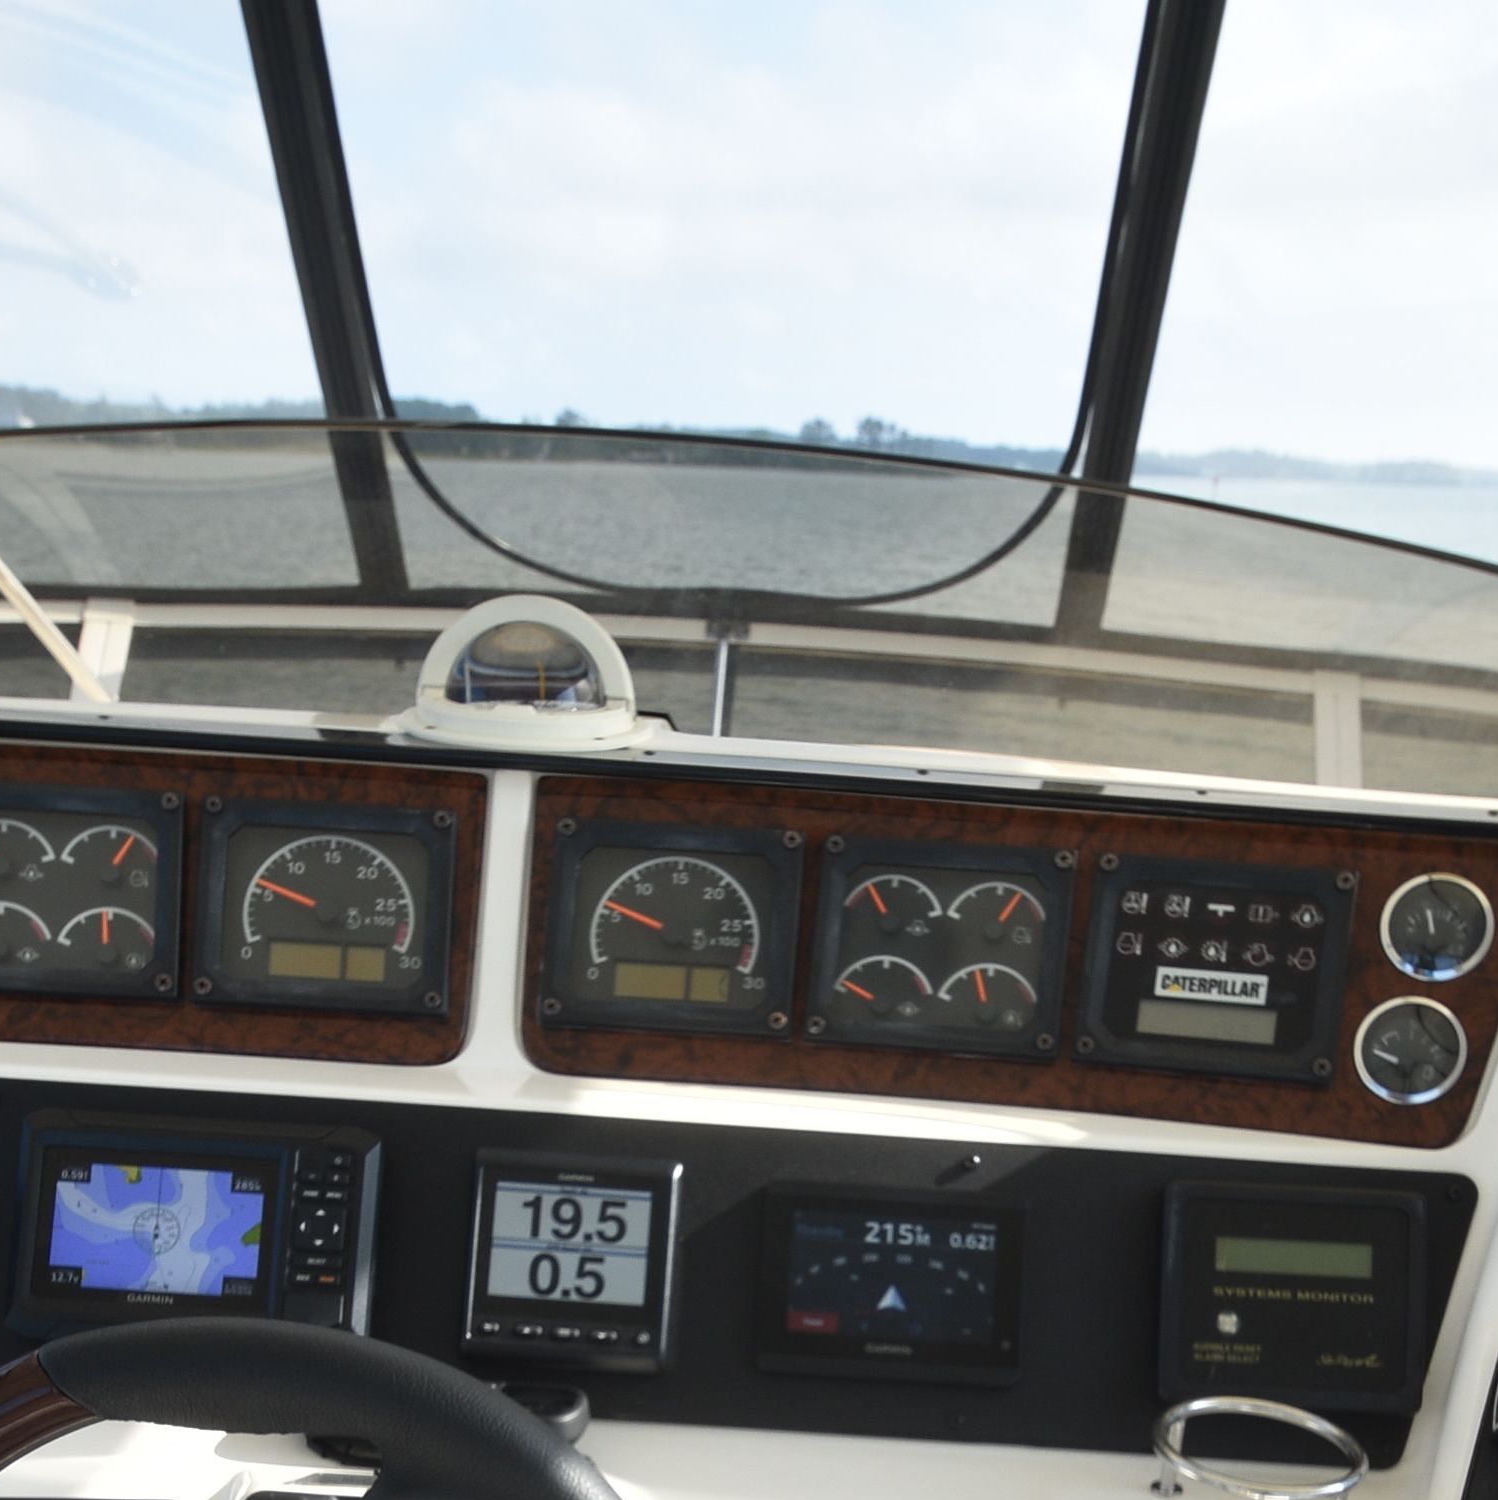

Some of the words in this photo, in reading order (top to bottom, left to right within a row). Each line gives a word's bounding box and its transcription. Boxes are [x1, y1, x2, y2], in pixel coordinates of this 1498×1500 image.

[324, 851, 342, 864] 15
[287, 862, 305, 875] 10
[356, 867, 379, 880] 20
[672, 873, 689, 885] 15
[634, 883, 653, 895] 10
[703, 888, 726, 900] 20
[375, 899, 397, 912] 25
[720, 920, 743, 932] 25
[241, 946, 252, 960] 0
[399, 956, 422, 970] 30
[742, 977, 765, 990] 30
[1161, 974, 1261, 998] CATERPILLAR
[521, 1195, 628, 1244] 19.5
[528, 1253, 606, 1300] 0.5
[127, 1293, 174, 1306] GARMIN
[1213, 1285, 1293, 1301] SYSTEMS
[1296, 1289, 1375, 1305] MONITOR
